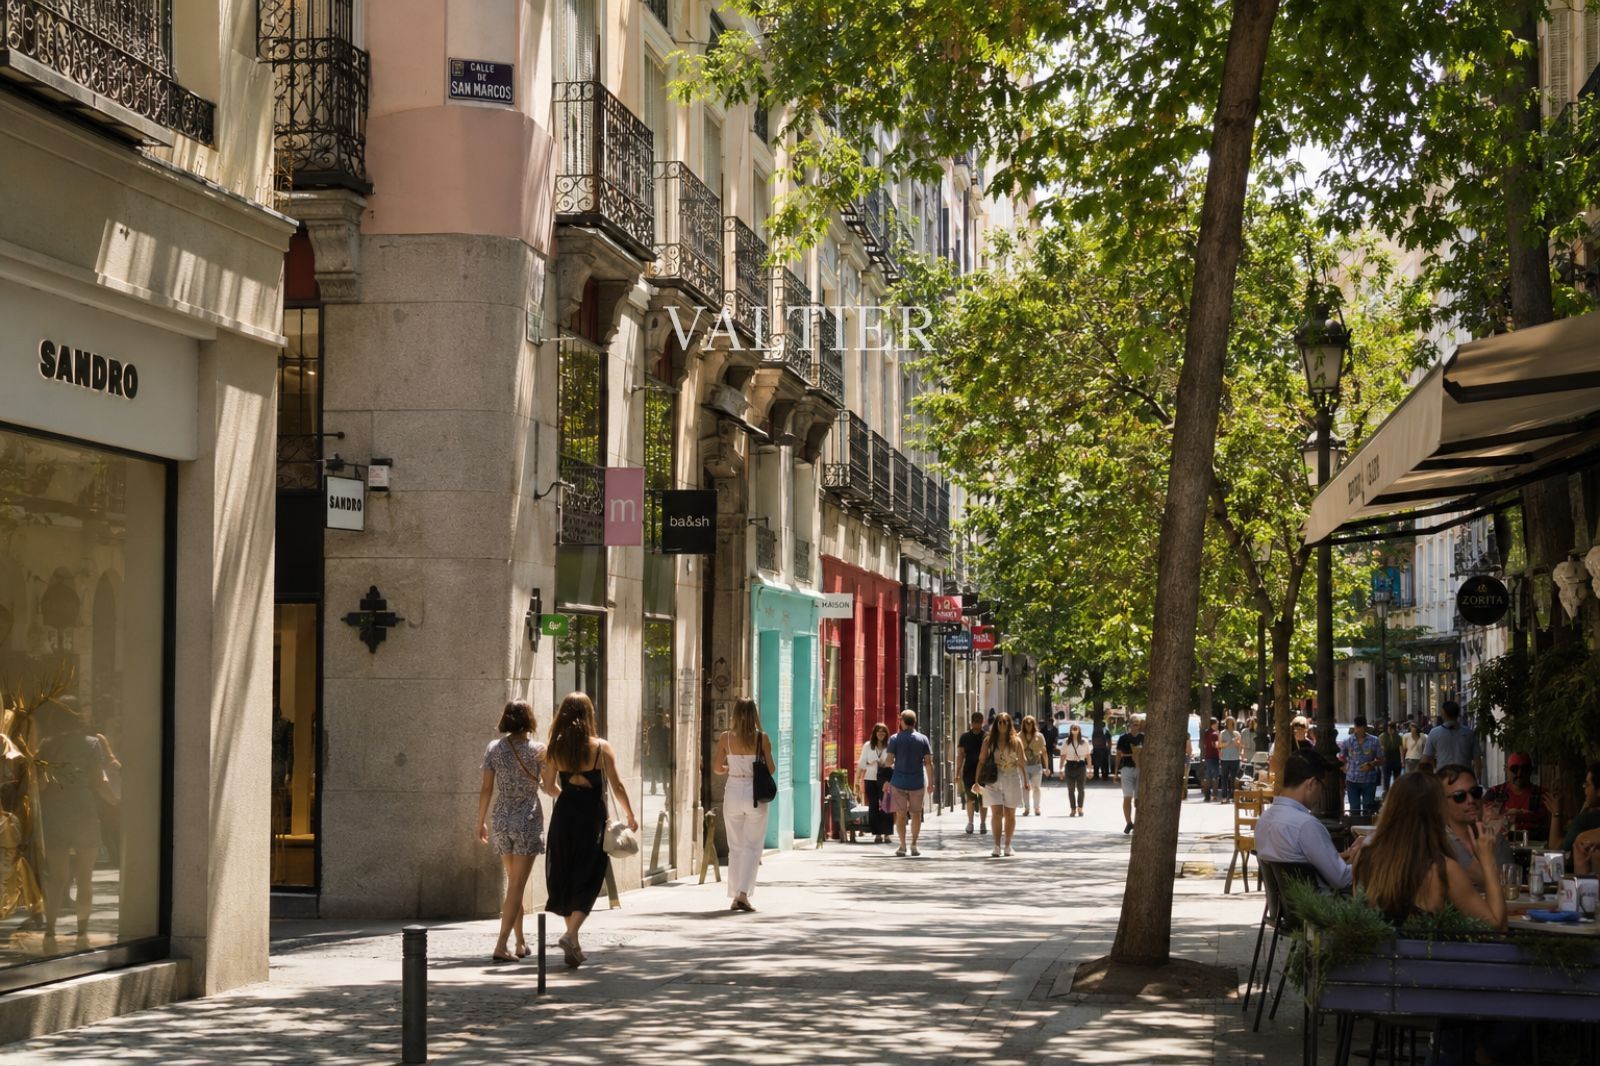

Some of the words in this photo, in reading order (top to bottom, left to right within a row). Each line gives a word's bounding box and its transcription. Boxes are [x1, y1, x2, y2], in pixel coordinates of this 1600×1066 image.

[470, 62, 495, 73] CALLE
[477, 73, 487, 82] DE
[451, 80, 471, 96] SAN
[473, 82, 512, 100] MARCOS
[38, 339, 139, 401] SANDRO
[329, 494, 362, 512] SANDRO
[610, 499, 636, 522] m
[670, 515, 710, 527] ba&sh
[1461, 595, 1504, 605] ZORITA
